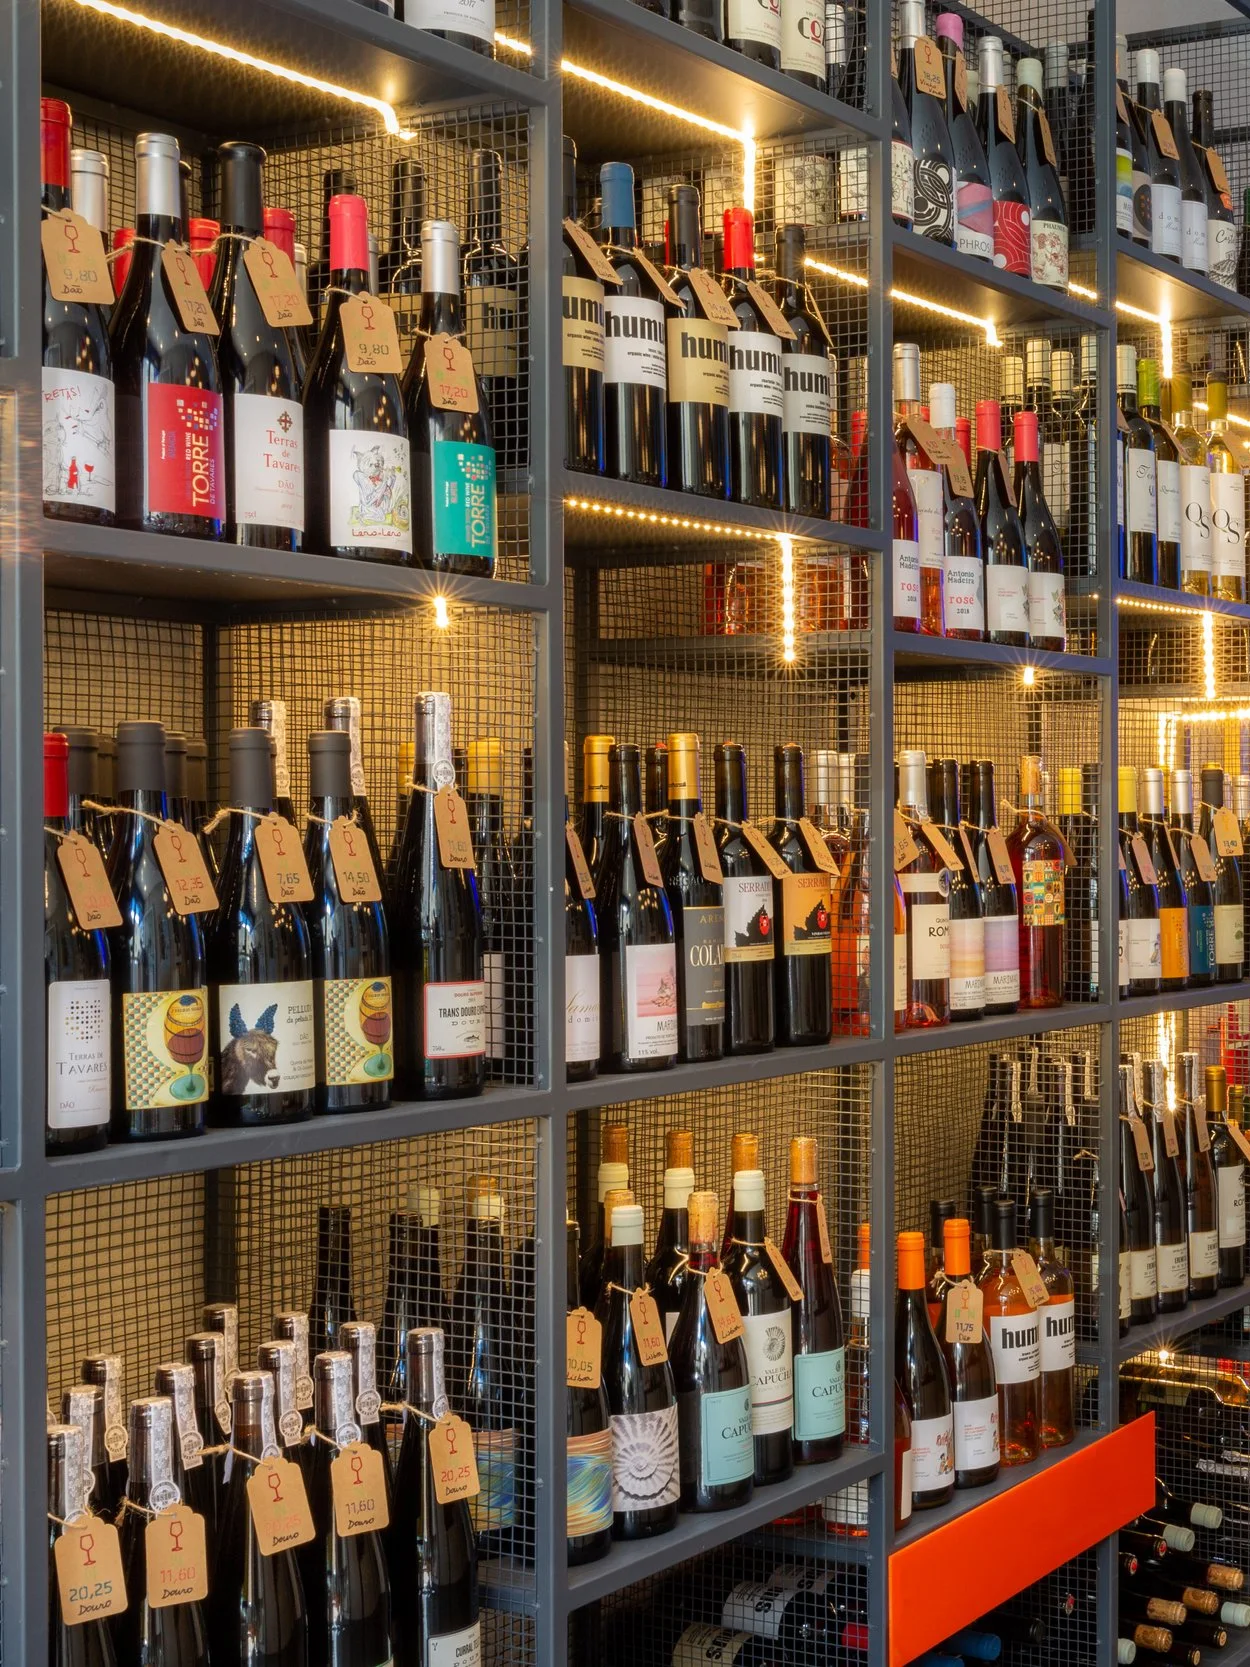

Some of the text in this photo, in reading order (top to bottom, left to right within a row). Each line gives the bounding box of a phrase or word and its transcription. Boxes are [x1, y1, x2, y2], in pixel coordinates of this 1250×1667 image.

[958, 238, 992, 254] PHROS
[63, 268, 98, 283] 9,80
[61, 284, 84, 295] Dão
[358, 343, 390, 357] 9,80
[356, 356, 377, 367] Dão
[42, 385, 82, 402] RETAS!
[439, 384, 468, 400] 17,20
[265, 429, 300, 450] Terras
[281, 450, 291, 458] de
[191, 432, 210, 508] TORRE
[471, 483, 487, 549] TORRE
[947, 569, 975, 579] Antonio
[947, 576, 975, 585] Madeira
[342, 871, 371, 885] 14,50
[438, 1005, 477, 1019] TRANS DOURO
[451, 1019, 482, 1027] DOUR
[955, 1321, 974, 1333] 11,75
[642, 1335, 662, 1349] 11,60
[567, 1357, 594, 1373] 10,05
[566, 1373, 594, 1382] Lisboa
[811, 1382, 844, 1398] CAPU
[721, 1423, 752, 1440] CAPU
[440, 1465, 471, 1482] 20,25
[444, 1484, 468, 1496] Douro
[345, 1498, 376, 1515] 11,60
[346, 1517, 376, 1530] Douro
[271, 1532, 300, 1547] Douro
[160, 1566, 197, 1584] 11,60
[69, 1580, 114, 1602] 20,25
[161, 1586, 194, 1600] Douro
[77, 1599, 113, 1616] Douro
